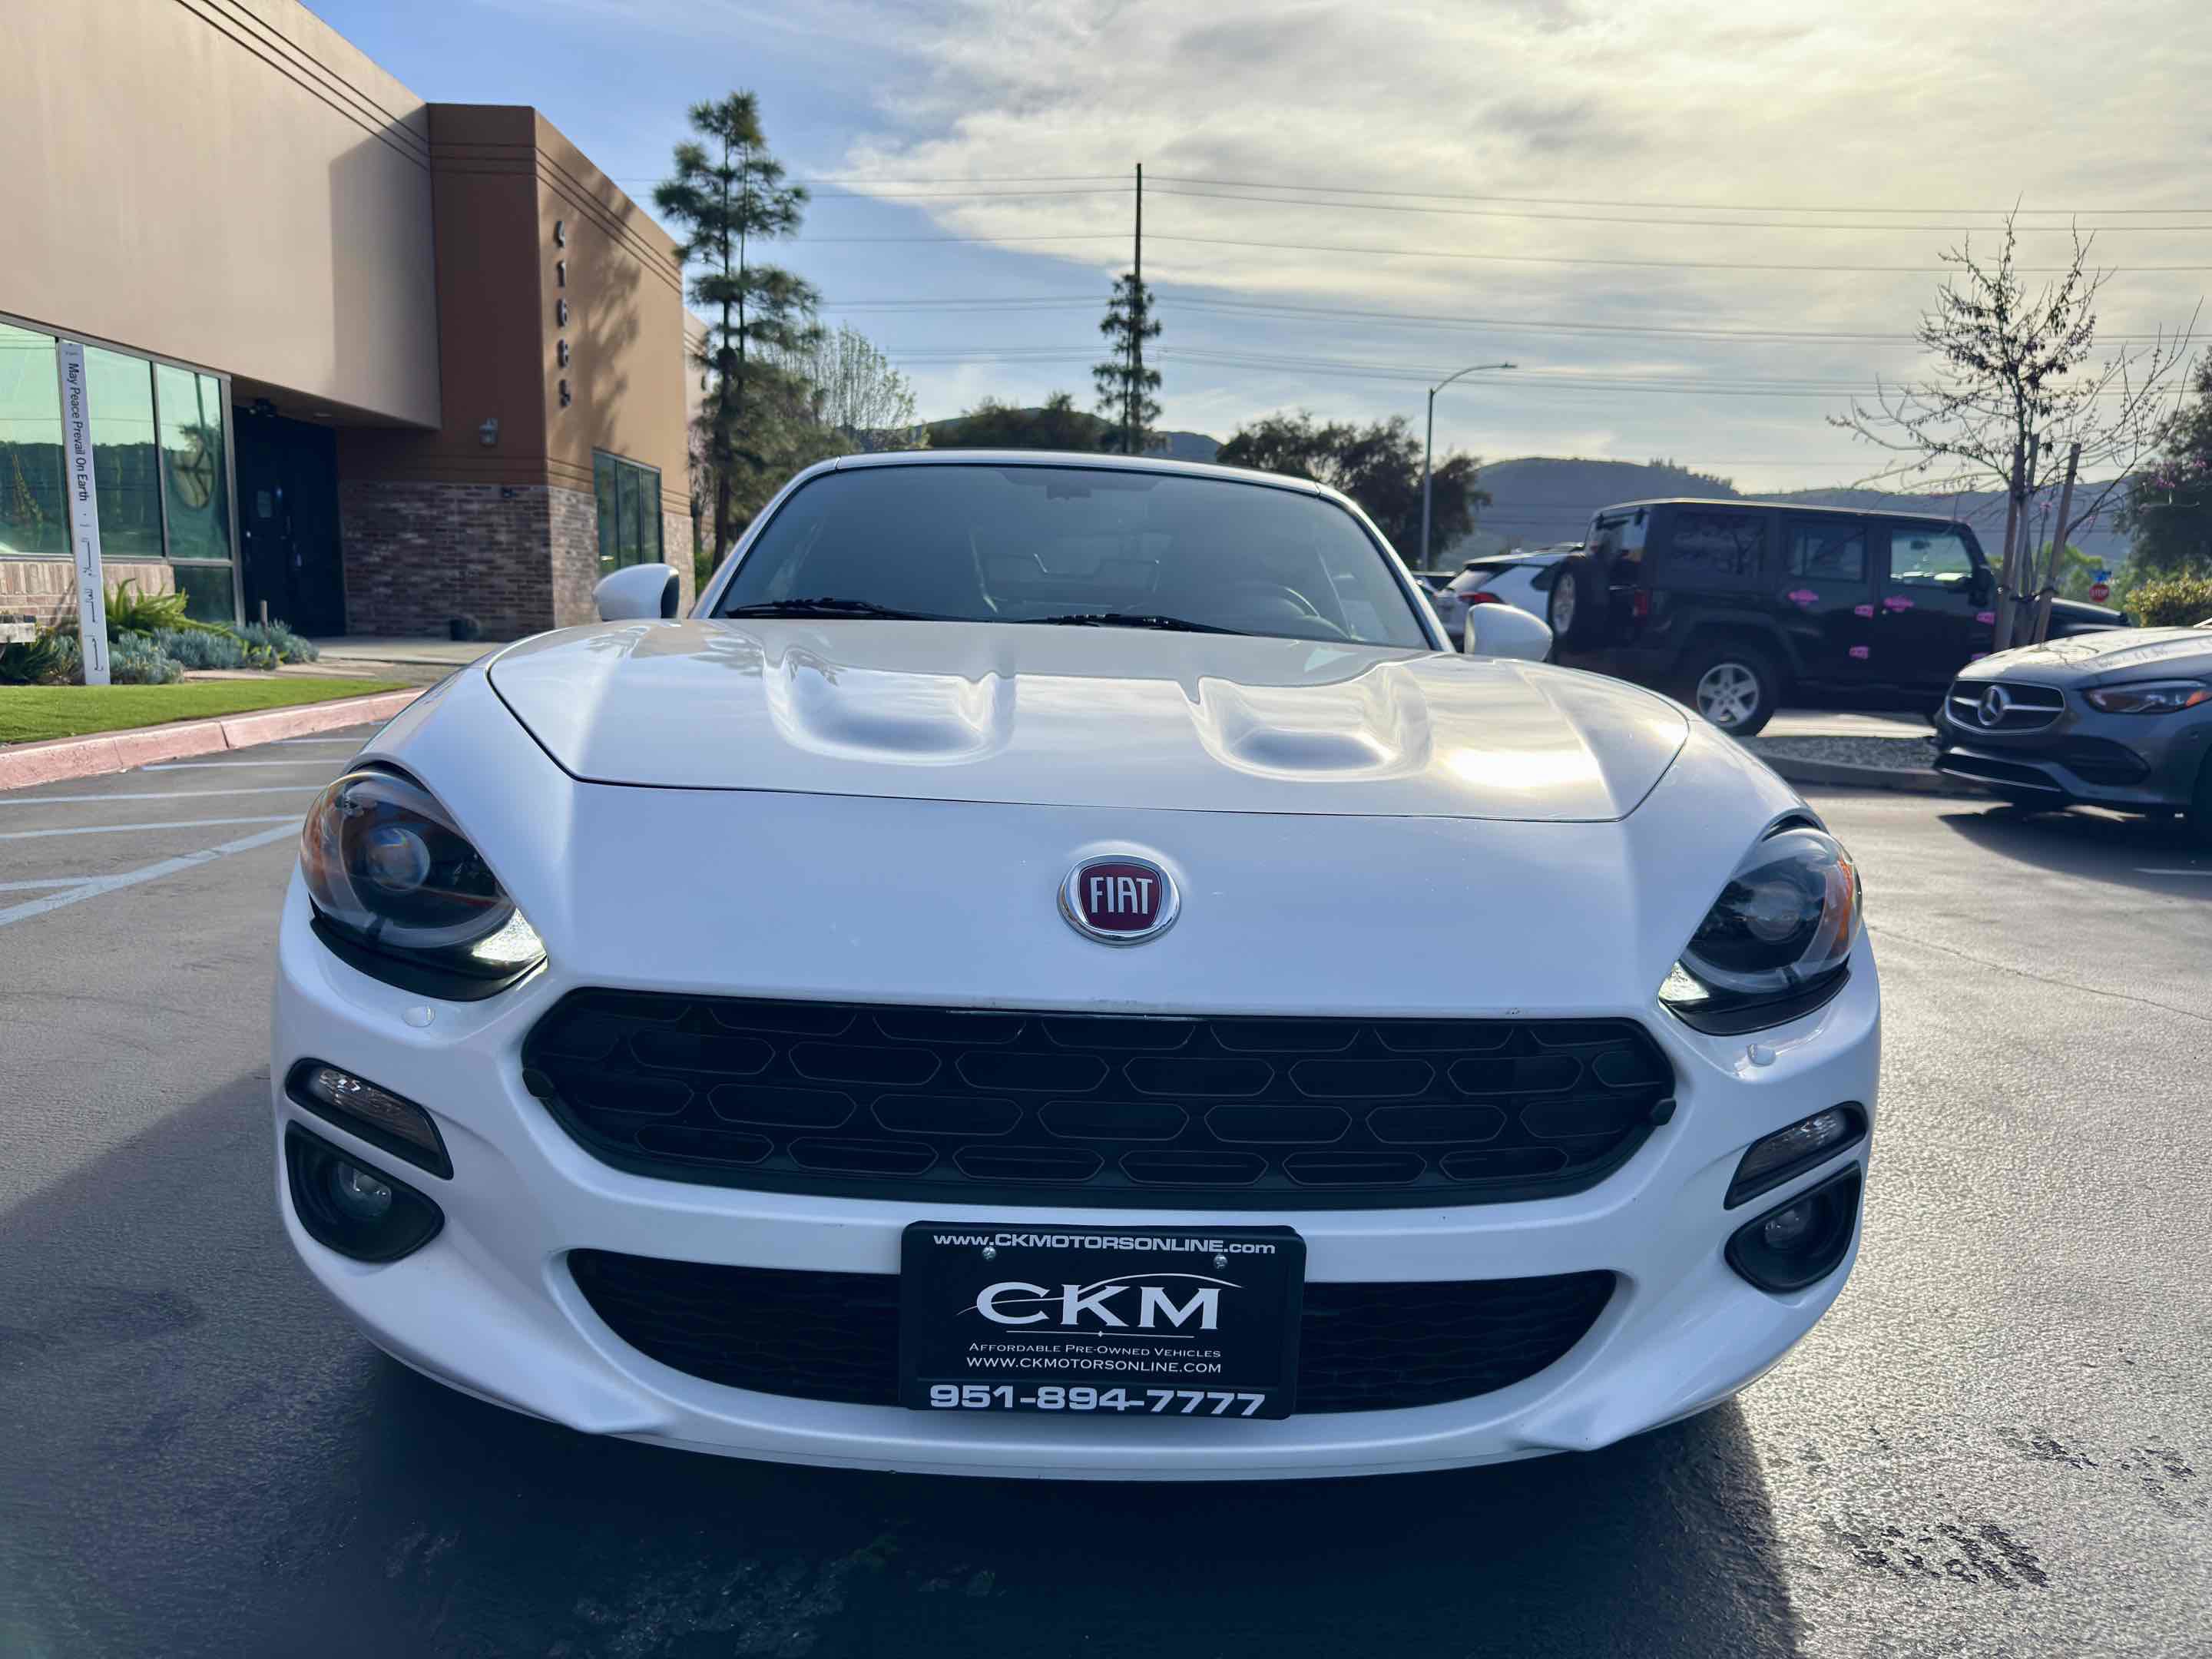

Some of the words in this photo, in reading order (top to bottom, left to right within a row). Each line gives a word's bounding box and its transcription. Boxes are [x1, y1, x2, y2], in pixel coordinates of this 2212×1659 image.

[67, 362, 79, 384] May
[70, 386, 81, 419] Peace
[73, 420, 84, 455] Prevail
[75, 455, 87, 472] On
[78, 474, 89, 501] Earth
[1090, 876, 1152, 914] FIAT
[933, 1233, 1276, 1254] www.CKMOTORSONLINE.com
[976, 1282, 1223, 1330] CKM
[966, 1357, 1222, 1373] WWW.CKMOTORSONLINE.COM
[930, 1384, 1266, 1416] 951-894-7777
